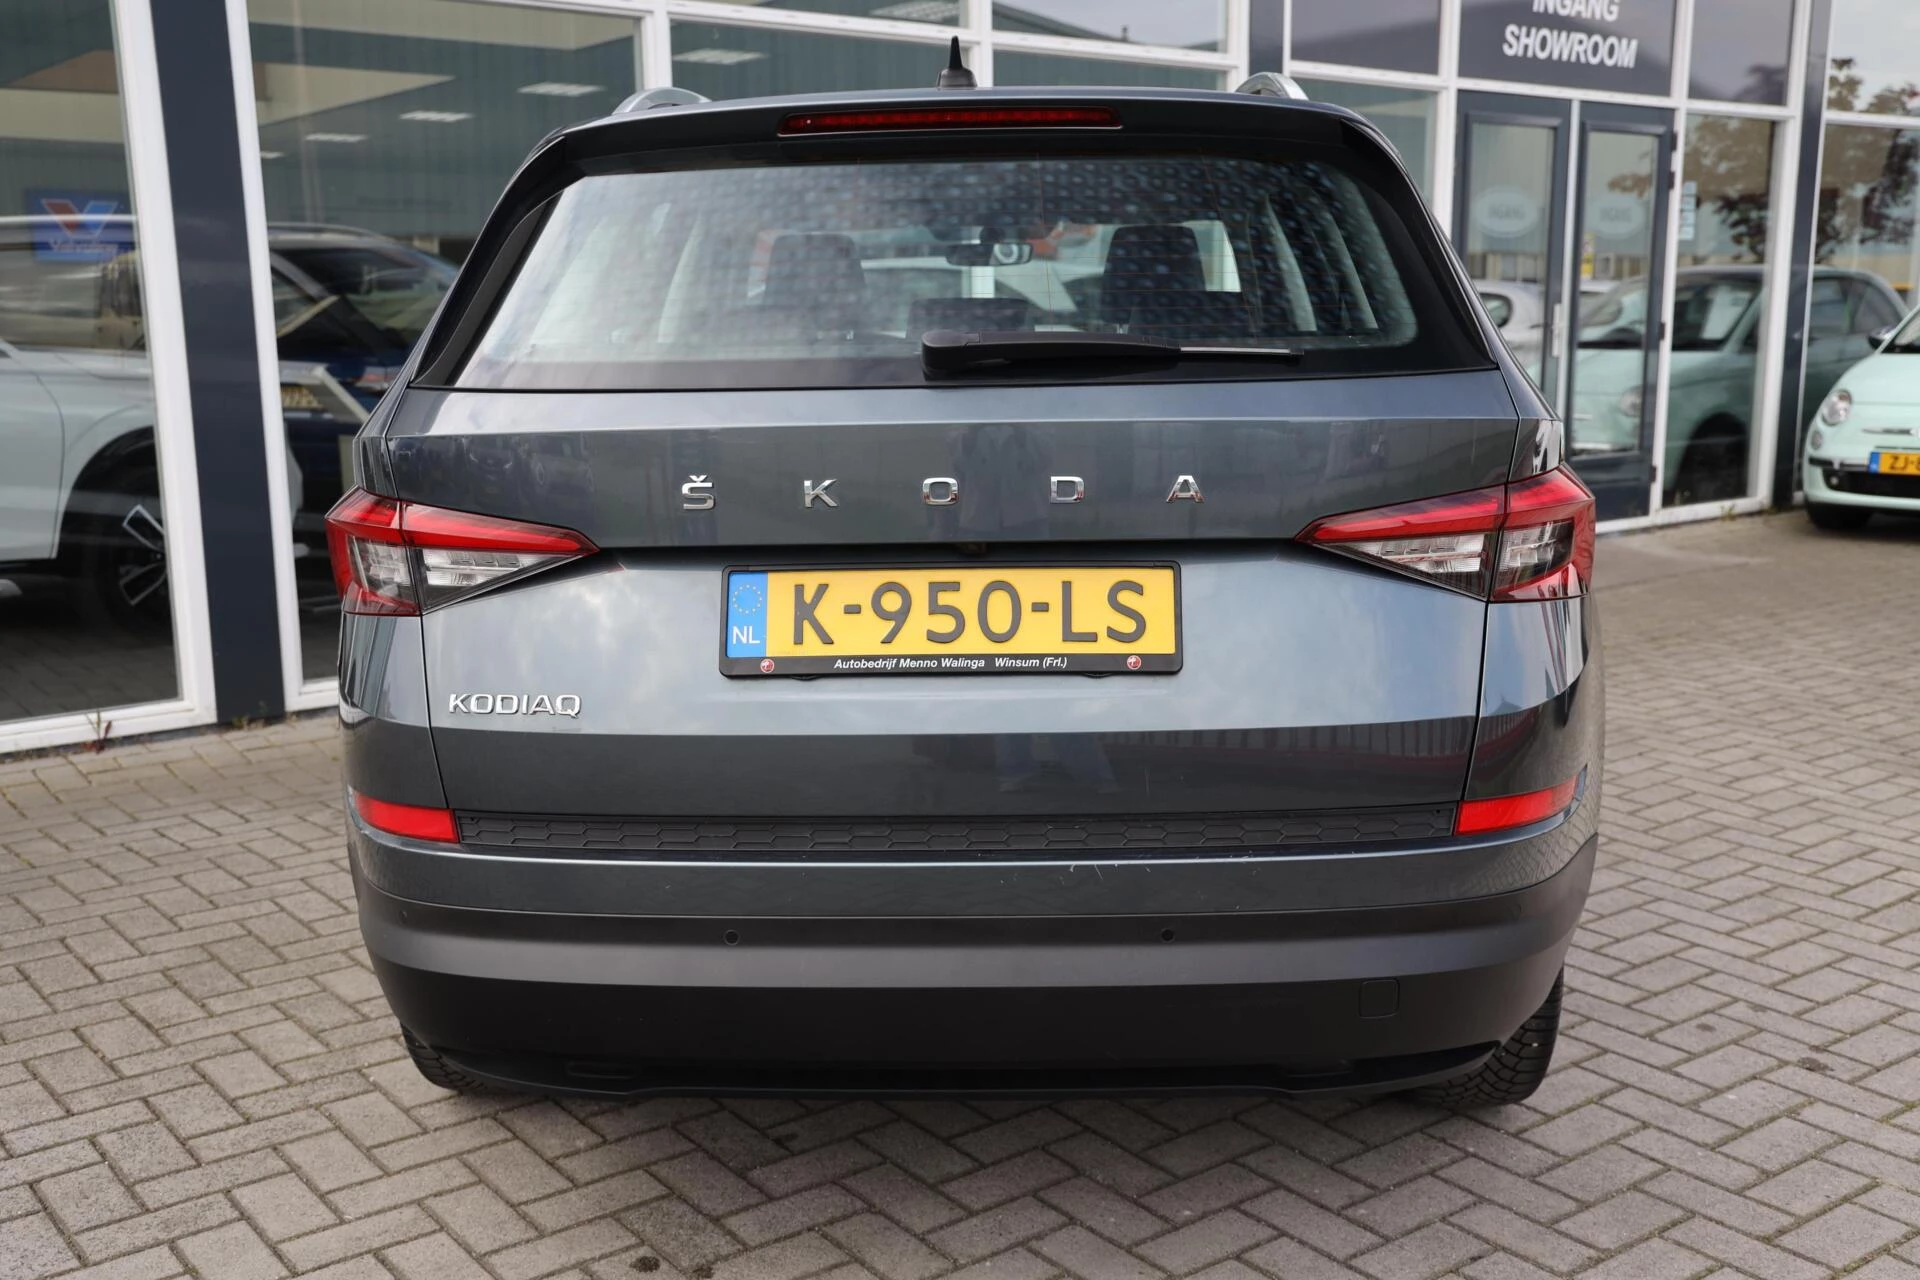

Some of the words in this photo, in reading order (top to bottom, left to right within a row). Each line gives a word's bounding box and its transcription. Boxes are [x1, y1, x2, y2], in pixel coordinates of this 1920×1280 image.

[1502, 23, 1638, 69] SHOWROOM
[681, 474, 1205, 510] ŠKODA
[793, 580, 1147, 645] K-950-LS
[732, 626, 761, 645] NL
[833, 657, 897, 670] Autobedrijf
[899, 657, 938, 668] Menno
[940, 657, 985, 669] Walinga
[994, 656, 1040, 668] Winsum
[1042, 656, 1068, 669] (Frl.)
[448, 693, 582, 718] KODIAQ
